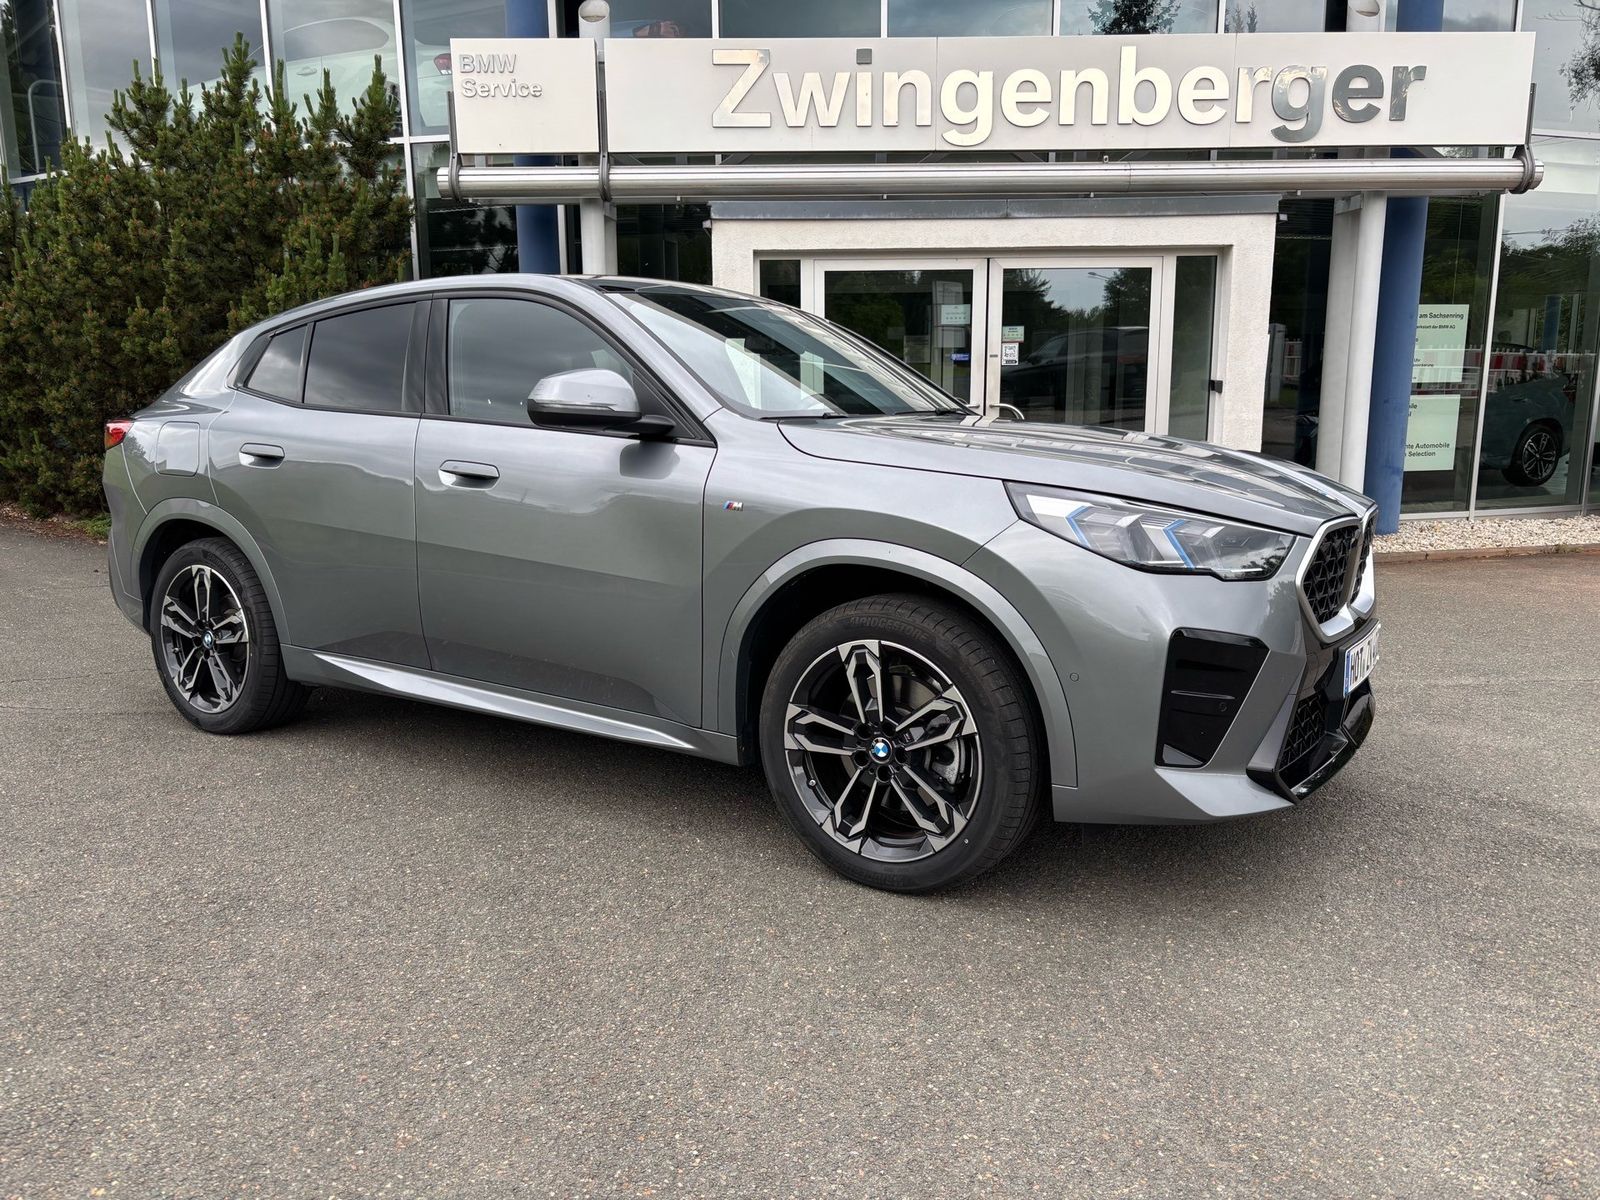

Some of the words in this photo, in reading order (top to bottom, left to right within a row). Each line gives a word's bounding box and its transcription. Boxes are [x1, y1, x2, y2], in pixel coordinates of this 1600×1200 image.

[459, 54, 517, 73] BMW
[461, 78, 543, 98] Service
[712, 45, 1427, 147] Zwingenberger
[1429, 312, 1465, 320] Sachsenring
